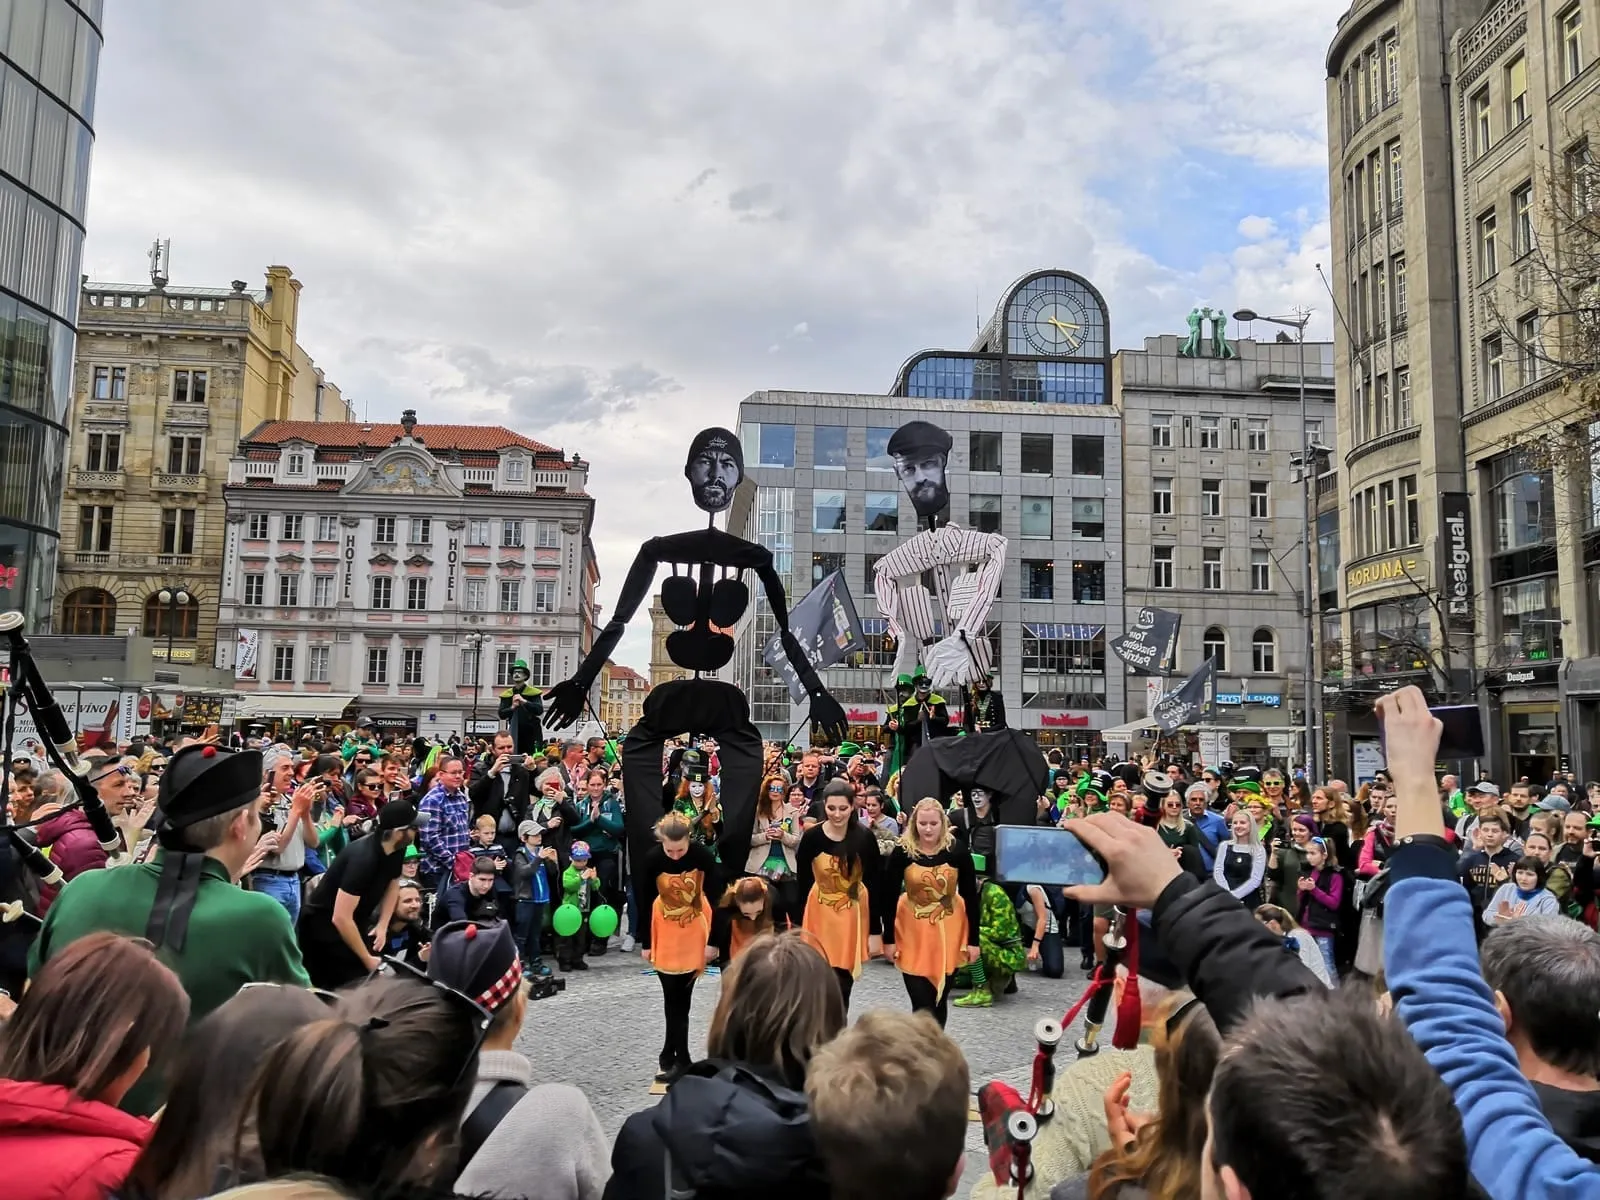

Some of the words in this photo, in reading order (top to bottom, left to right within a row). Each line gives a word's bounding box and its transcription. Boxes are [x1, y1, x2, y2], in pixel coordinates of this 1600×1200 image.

[344, 535, 355, 598] HOTEL
[447, 538, 458, 601] HOTEL
[1446, 516, 1470, 614] Desigual
[79, 702, 108, 714] VÍNO
[377, 719, 407, 727] CHANGE
